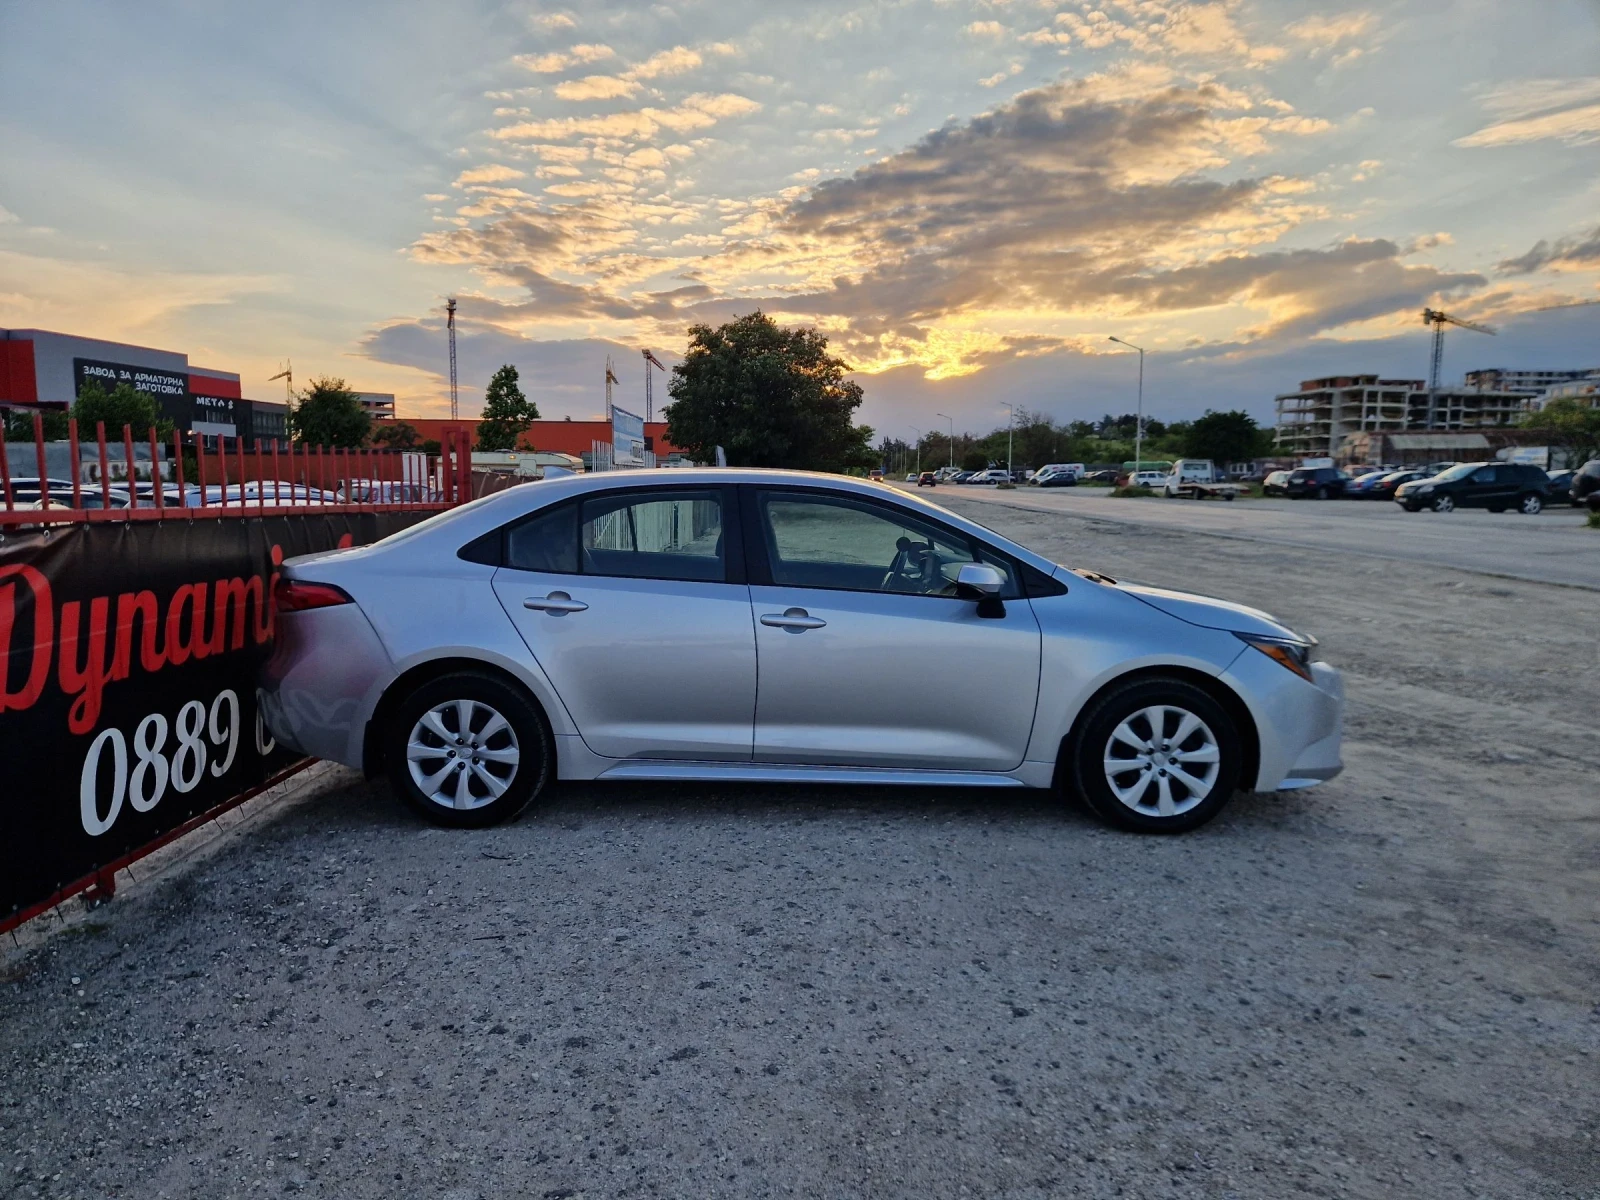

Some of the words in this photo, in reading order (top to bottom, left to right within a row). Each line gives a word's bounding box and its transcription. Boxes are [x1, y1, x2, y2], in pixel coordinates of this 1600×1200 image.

[83, 365, 116, 379] ЗАВОД
[120, 370, 131, 380] ЗА
[134, 373, 184, 387] АРМАТУРНА
[136, 382, 184, 395] ЗАГОТОВКА
[80, 689, 240, 836] 0889
